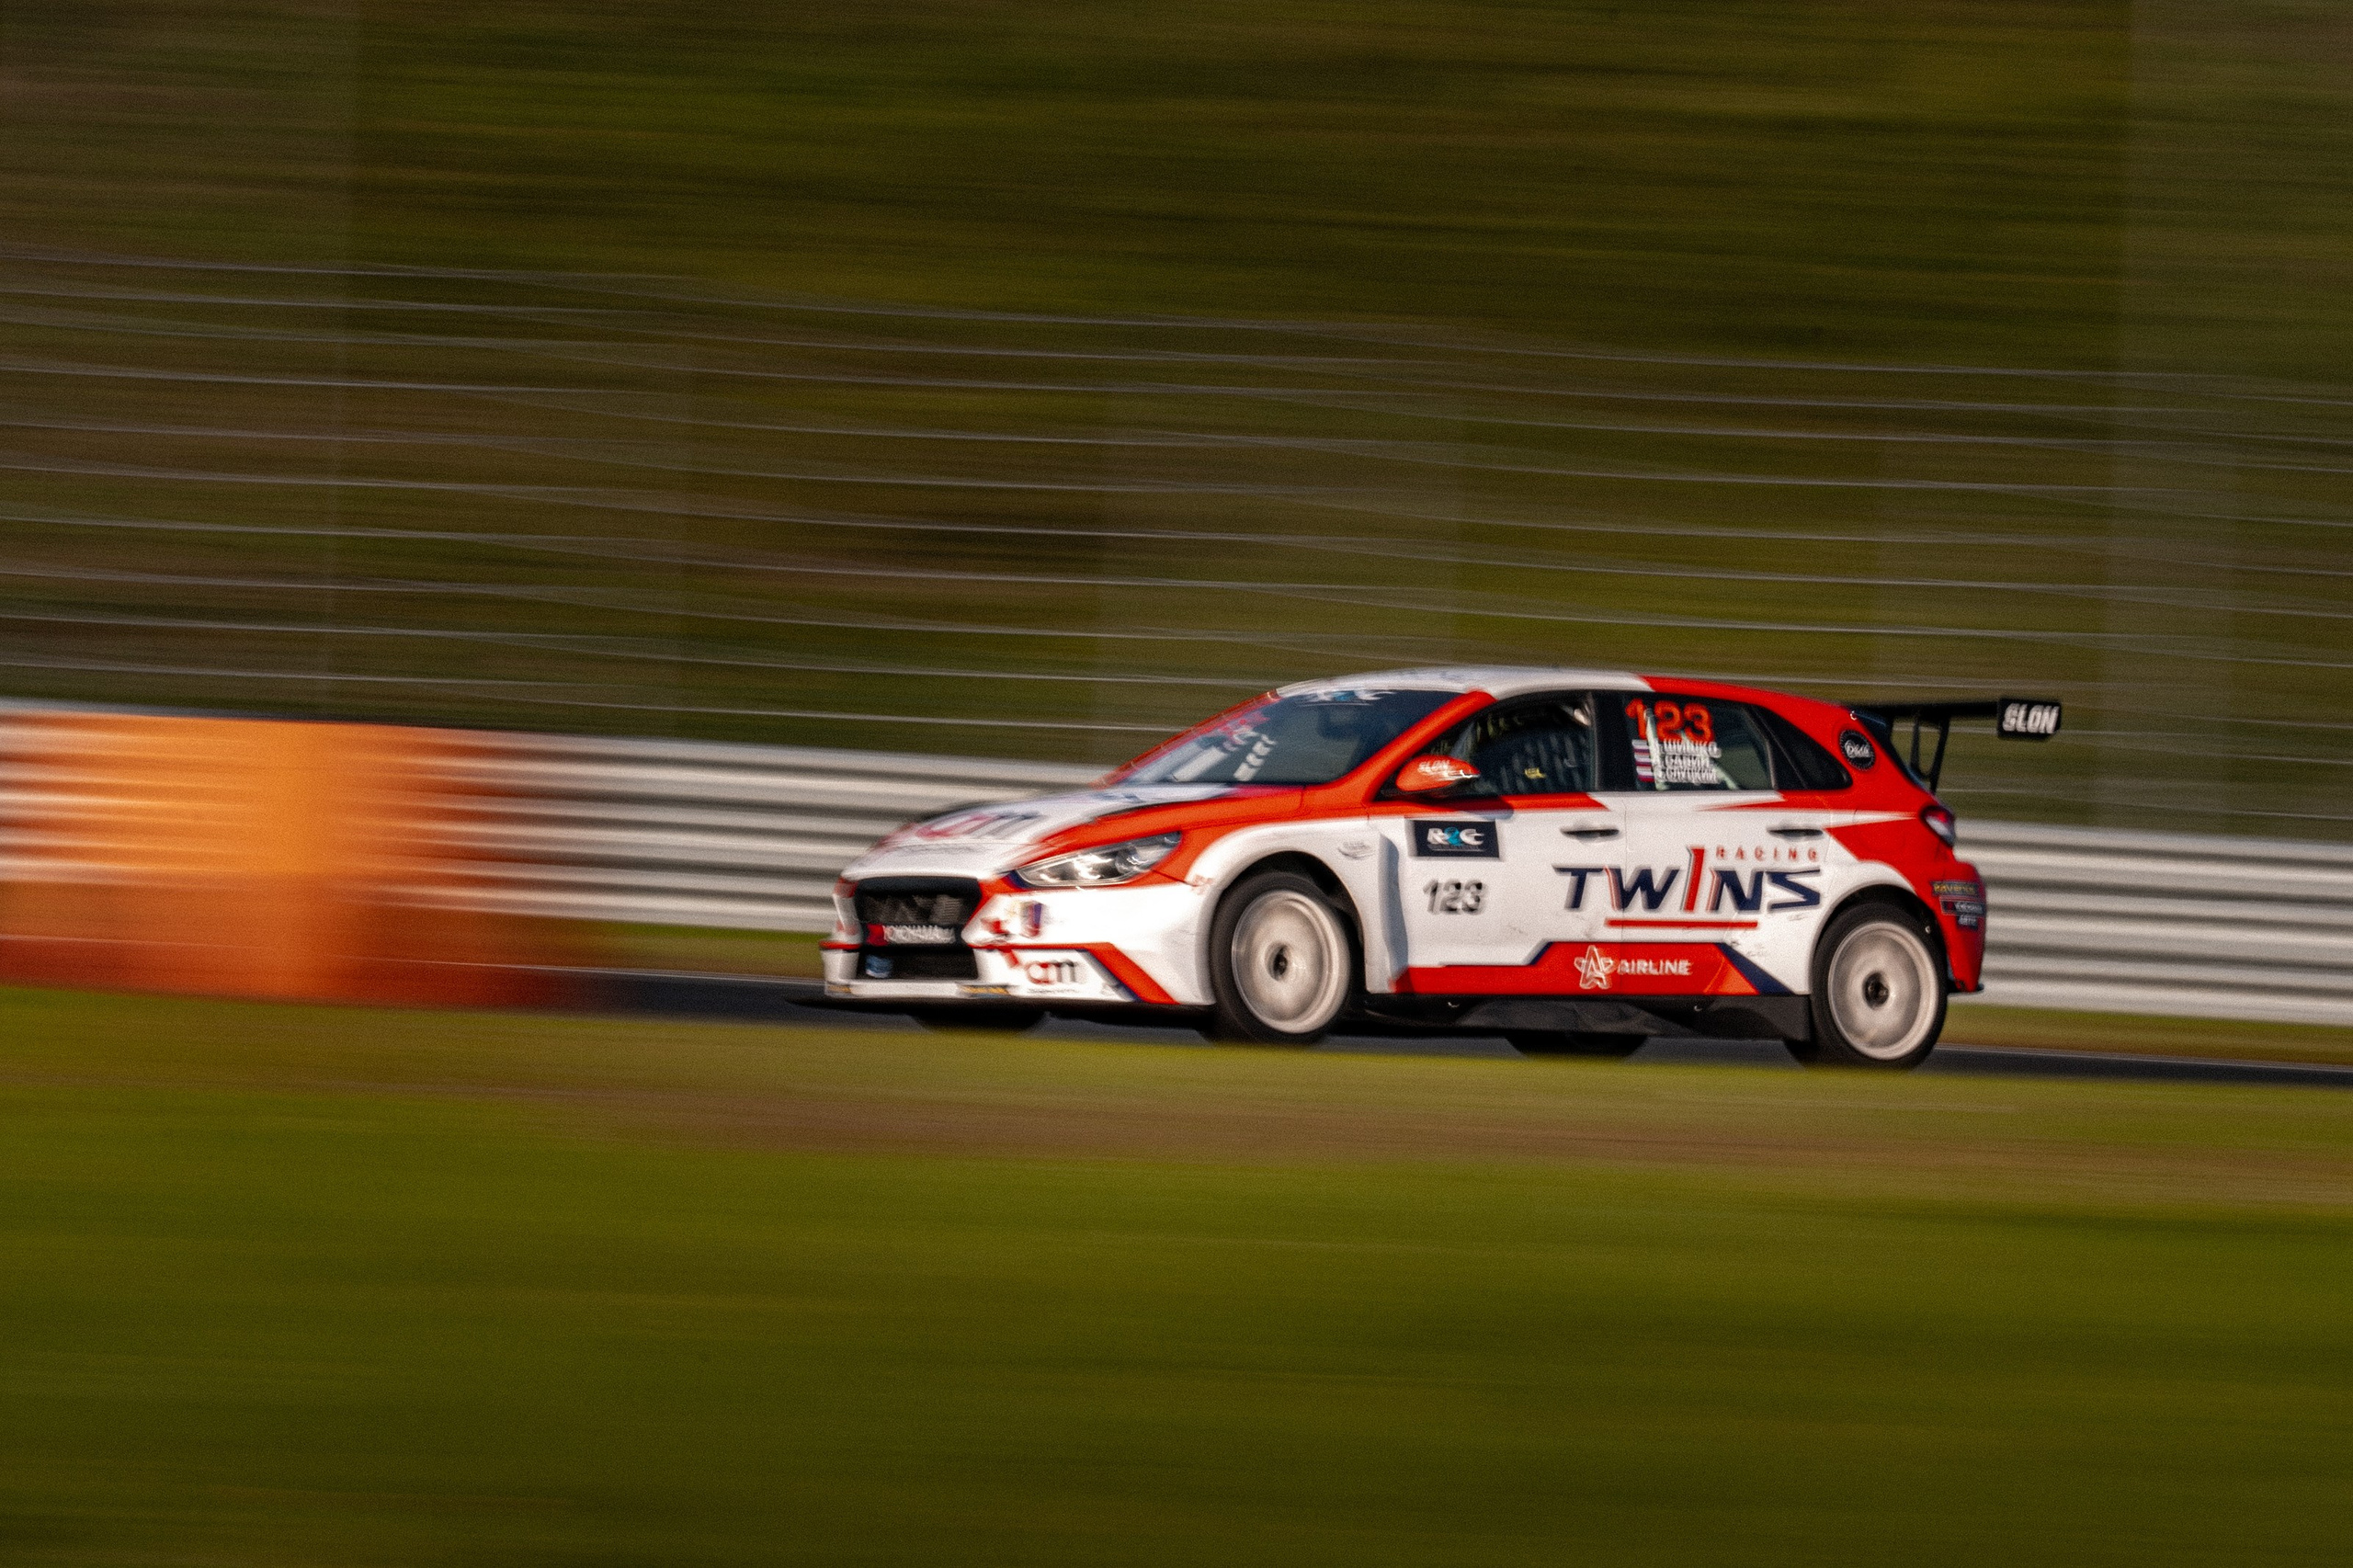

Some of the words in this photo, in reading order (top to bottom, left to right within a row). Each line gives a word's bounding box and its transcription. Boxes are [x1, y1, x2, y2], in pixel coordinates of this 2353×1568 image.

[1625, 698, 1715, 745] 123
[2003, 703, 2060, 733] SLON
[1716, 846, 1818, 860] RACING
[1552, 846, 1821, 914] TWINS
[1423, 879, 1488, 915] 123
[1618, 960, 1691, 976] AIRLINE
